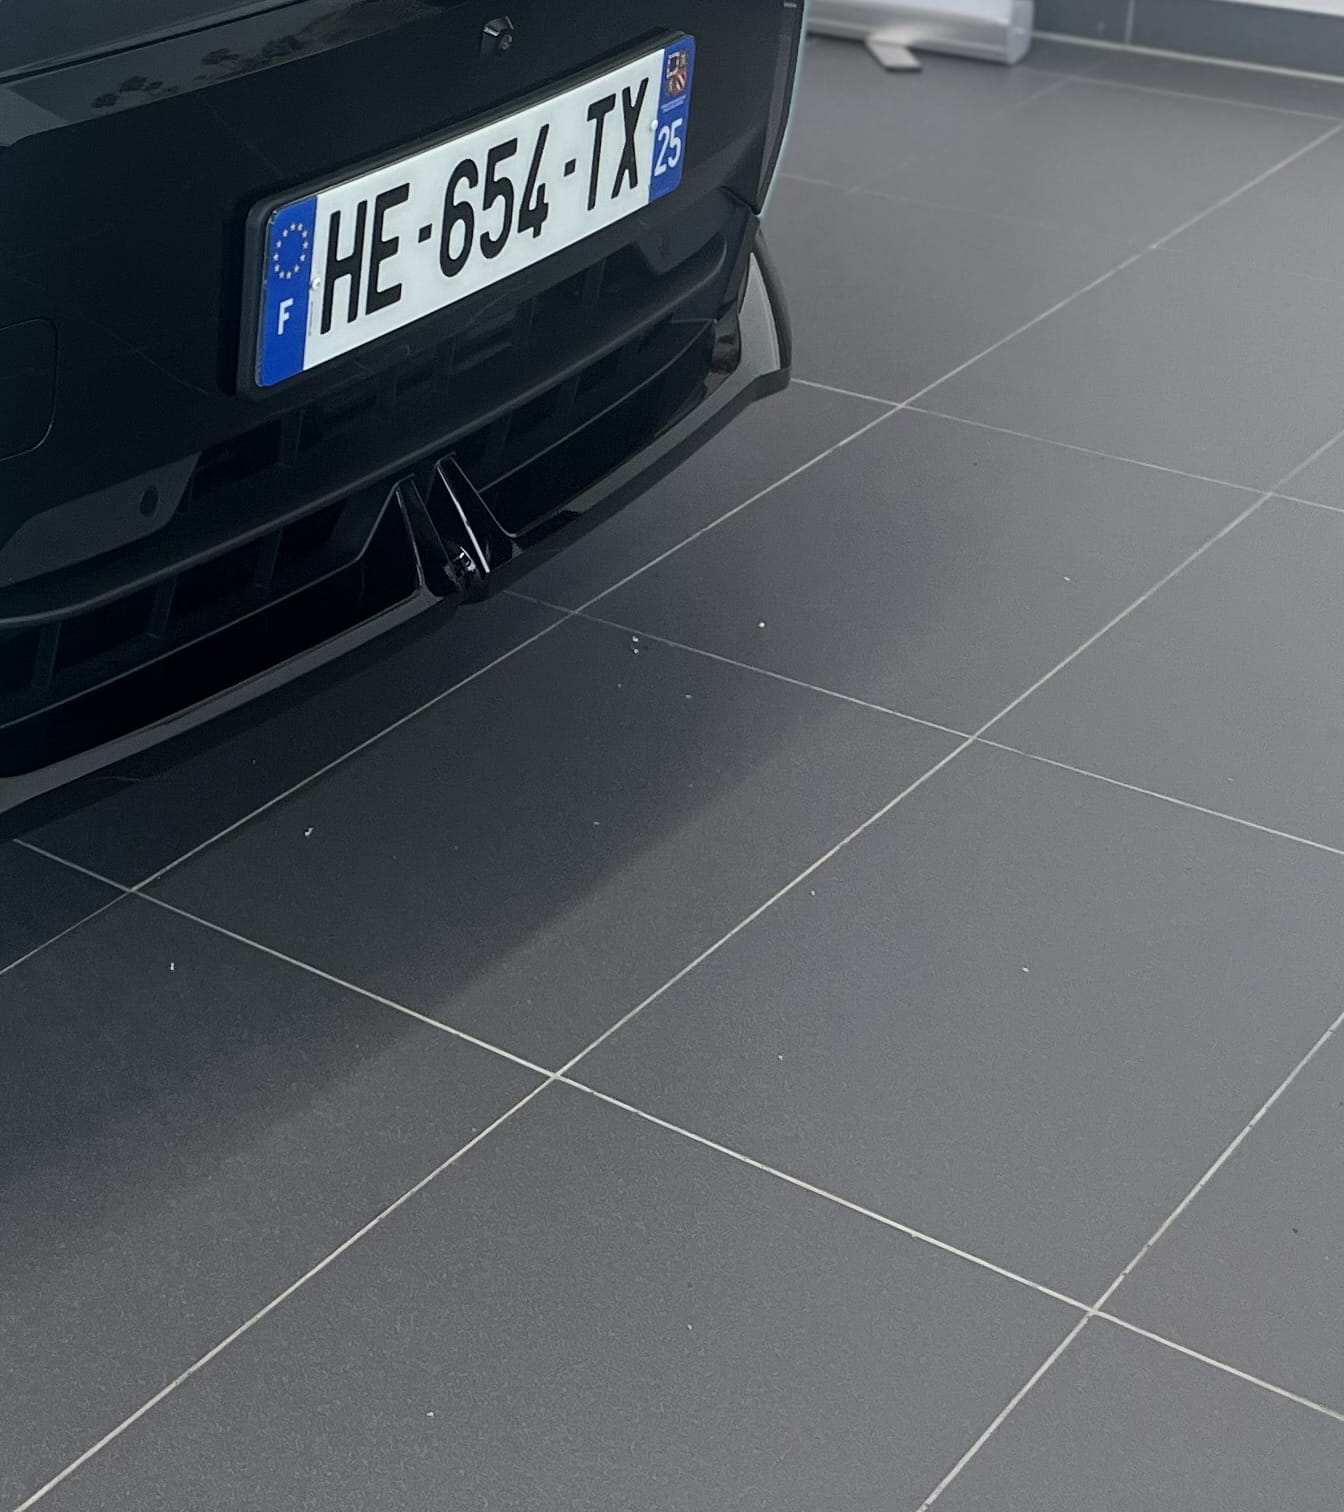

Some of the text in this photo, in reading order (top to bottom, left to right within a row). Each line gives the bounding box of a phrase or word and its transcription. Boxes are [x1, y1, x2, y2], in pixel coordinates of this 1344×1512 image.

[654, 117, 683, 178] 25
[319, 76, 650, 335] HE-654-TX
[276, 297, 294, 335] F
